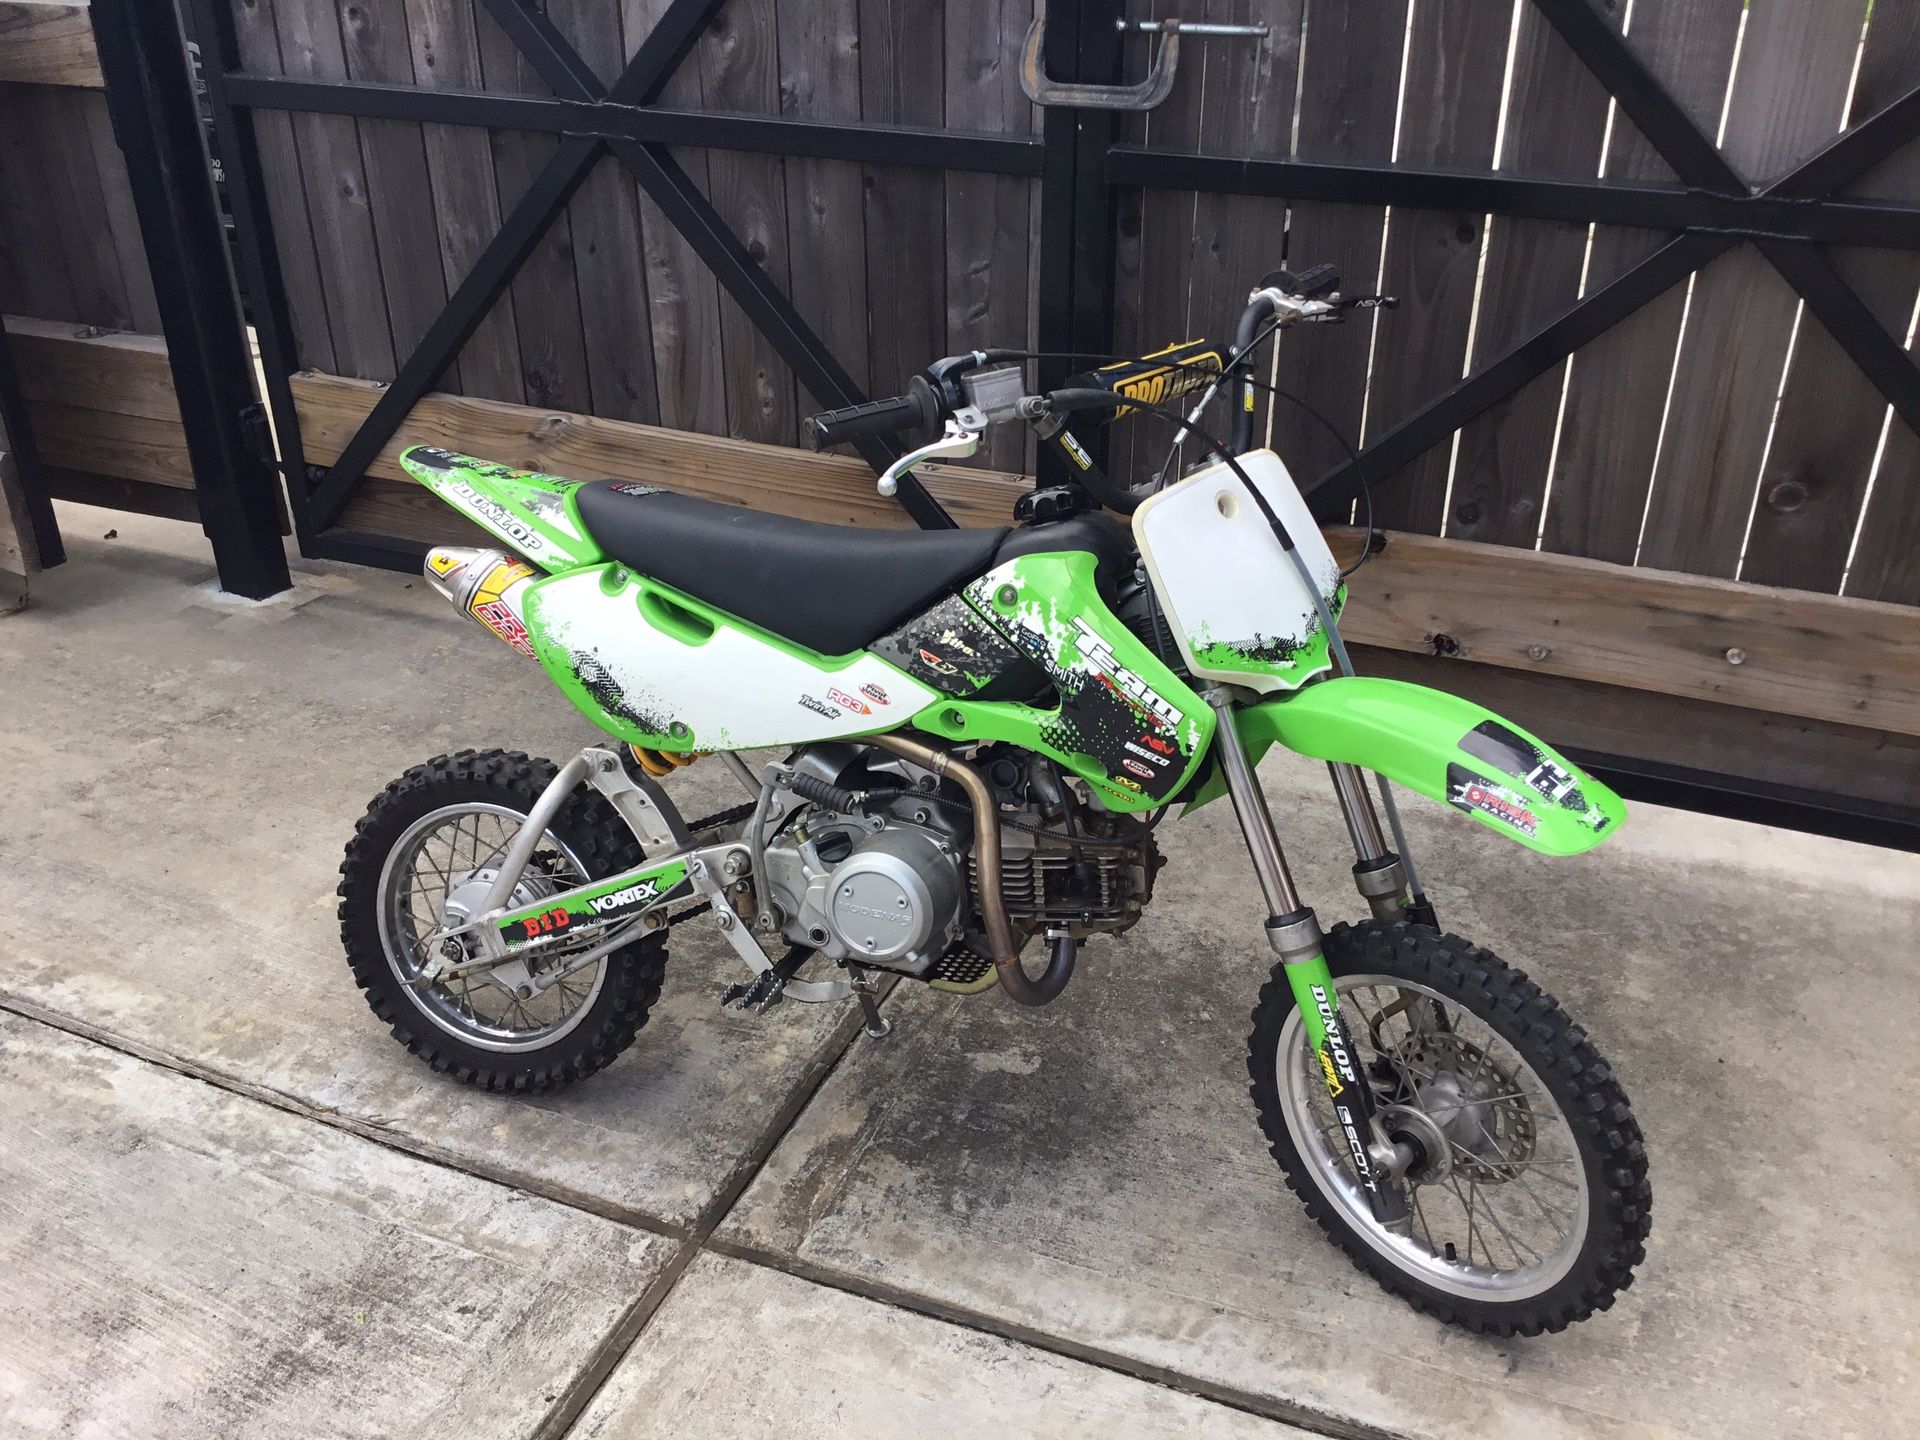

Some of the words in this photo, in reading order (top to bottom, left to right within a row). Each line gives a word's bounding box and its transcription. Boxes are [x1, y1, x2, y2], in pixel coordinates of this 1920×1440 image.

[453, 483, 542, 549] DUNLOP
[1021, 628, 1046, 647] GoPro
[1044, 659, 1085, 692] SMITH
[827, 687, 863, 714] RG3
[1124, 741, 1171, 767] WISECO
[1480, 802, 1533, 832] RACING
[1484, 793, 1535, 827] RISK
[589, 880, 658, 913] VORTEX
[835, 900, 913, 927] MODENAS
[1310, 984, 1355, 1083] DUNLOP
[1344, 1126, 1377, 1193] SCOTT
